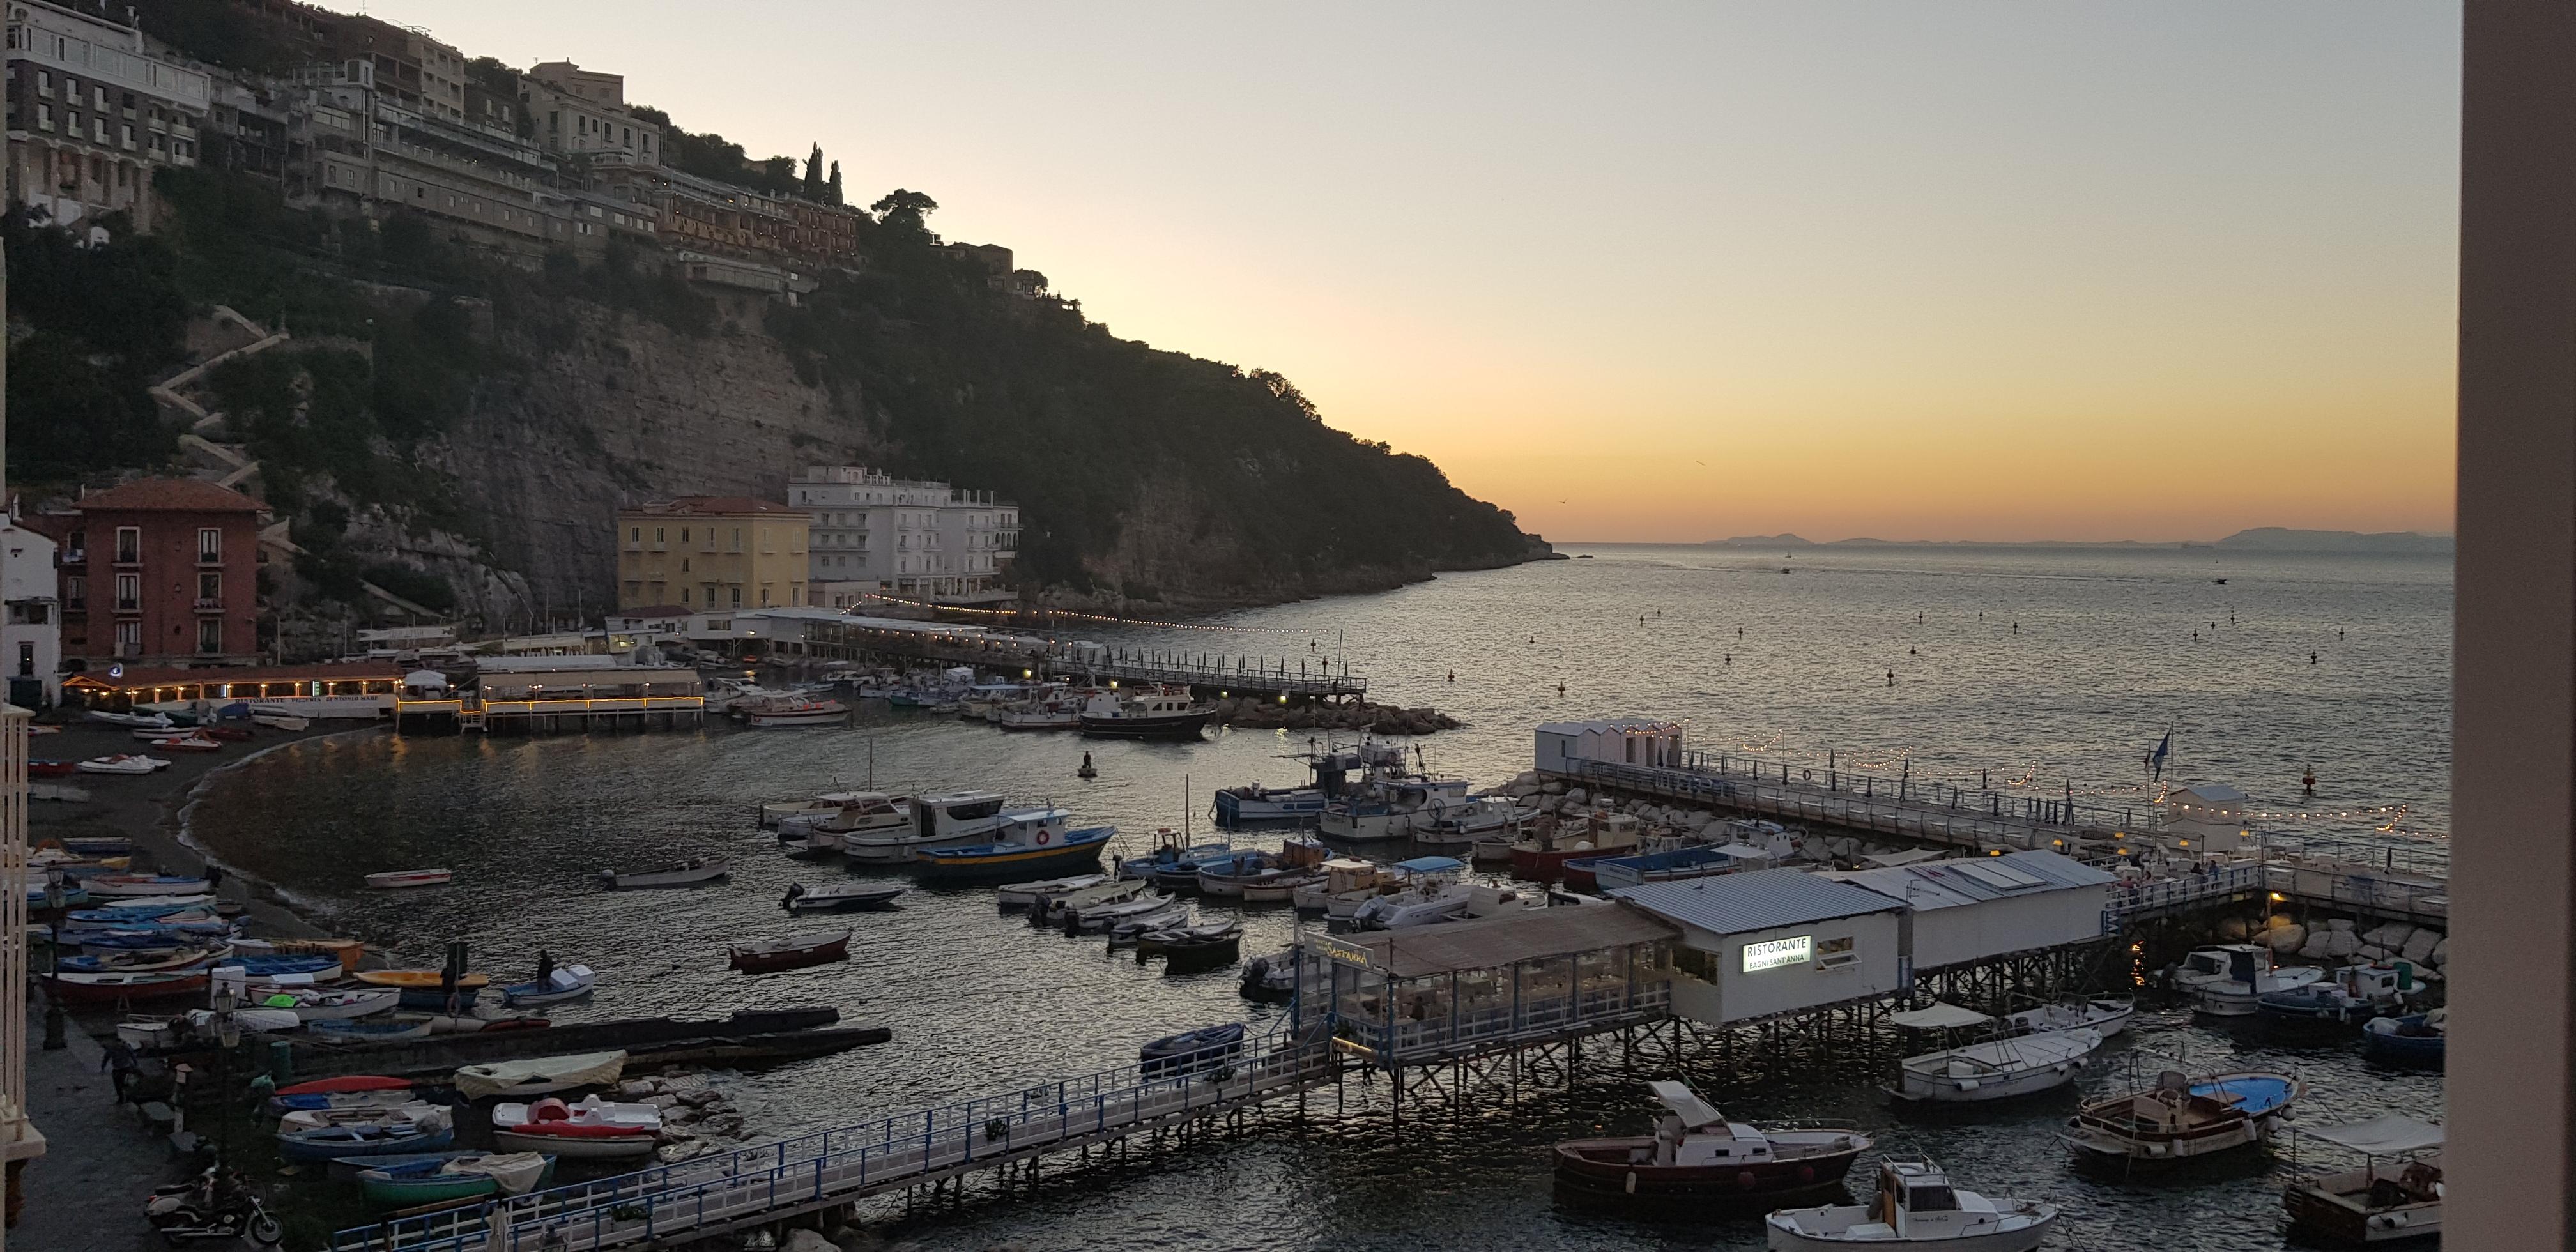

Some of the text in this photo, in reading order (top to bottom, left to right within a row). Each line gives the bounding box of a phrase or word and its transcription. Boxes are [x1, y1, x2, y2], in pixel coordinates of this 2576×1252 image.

[1747, 938, 1806, 957] RISTORANTE
[1749, 954, 1804, 969] BAGNI SANT'ANNA
